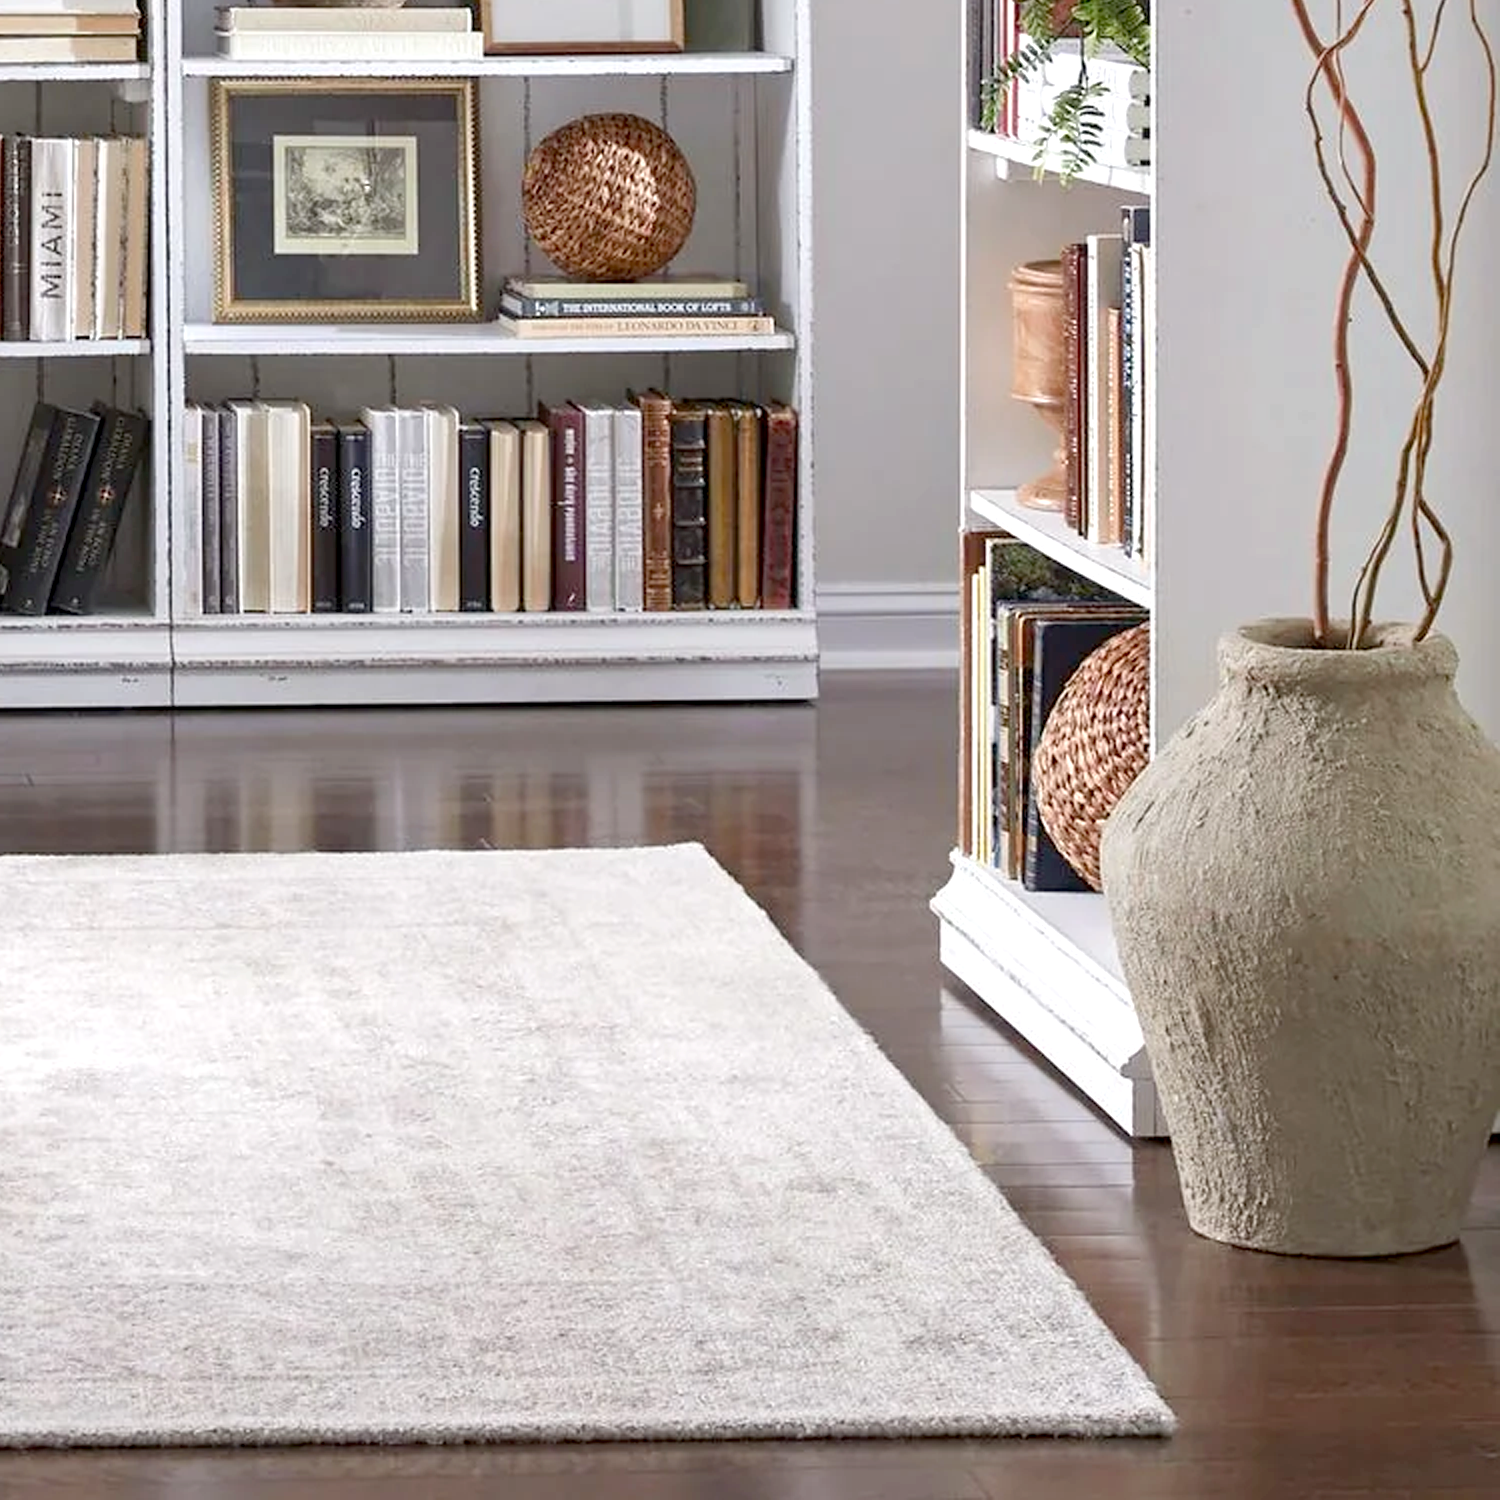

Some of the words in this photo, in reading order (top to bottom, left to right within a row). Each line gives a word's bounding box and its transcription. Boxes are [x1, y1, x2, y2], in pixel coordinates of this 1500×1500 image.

[41, 192, 63, 299] MIAMI
[562, 302, 580, 312] THE
[582, 302, 656, 312] INTERNATIONAL
[658, 302, 684, 312] BOOK
[686, 302, 699, 312] OF
[701, 302, 731, 312] LOFTS
[617, 320, 683, 331] LEONARDO
[685, 320, 701, 330] DA
[702, 320, 738, 330] VINCI
[318, 467, 330, 528] crescendo
[351, 467, 366, 529] crescendo
[469, 466, 484, 528] crescendo
